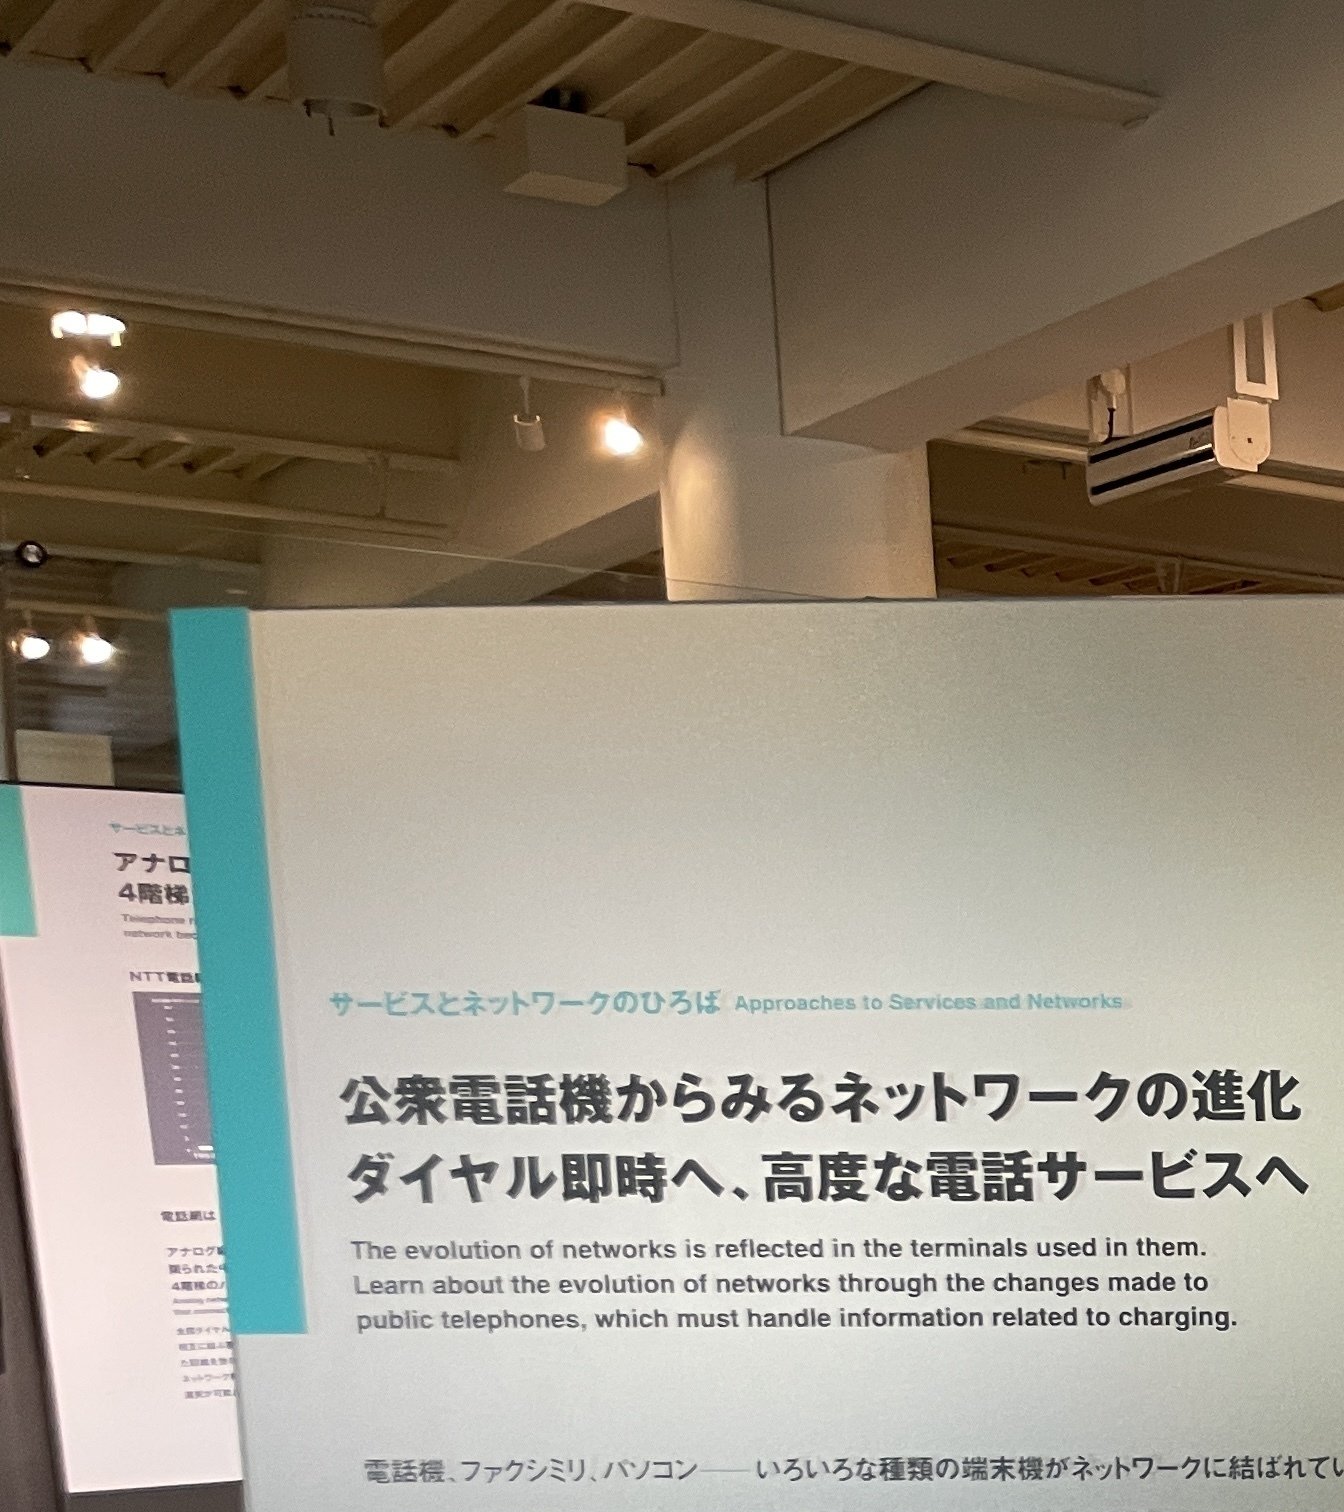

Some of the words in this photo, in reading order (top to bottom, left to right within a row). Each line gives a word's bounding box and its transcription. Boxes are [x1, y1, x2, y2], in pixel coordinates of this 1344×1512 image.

[112, 852, 190, 873] アナロ
[329, 990, 720, 1016] サービスとネットワークのひろば
[734, 995, 857, 1014] Approaches
[862, 995, 883, 1010] to
[888, 993, 977, 1011] Services
[984, 993, 1022, 1011] and
[1027, 992, 1123, 1010] Networks
[340, 1069, 1302, 1126] 公衆電話機からみるネットワークの進化
[347, 1149, 1310, 1203] ダイヤル即時へ、高度な電話サービスへ
[350, 1241, 397, 1260] The
[405, 1240, 521, 1259] evolution
[530, 1240, 553, 1259] of
[563, 1240, 677, 1259] networks
[685, 1239, 706, 1258] is
[715, 1239, 824, 1258] reflected
[832, 1238, 855, 1257] in
[863, 1238, 902, 1257] the
[910, 1238, 1028, 1257] terminals
[1037, 1238, 1096, 1257] used
[1106, 1237, 1127, 1256] in
[1136, 1237, 1206, 1256] them.
[353, 1276, 424, 1294] Learn
[433, 1276, 504, 1294] about
[510, 1275, 550, 1293] the
[558, 1274, 675, 1293] evolution
[684, 1274, 707, 1293] of
[716, 1274, 830, 1293] networks
[838, 1273, 937, 1297] through
[945, 1273, 985, 1292] the
[993, 1273, 1099, 1297] changes
[1108, 1272, 1176, 1291] made
[1184, 1273, 1208, 1291] to
[357, 1310, 434, 1334] public
[441, 1310, 587, 1333] telephones,
[595, 1309, 668, 1328] which
[677, 1310, 739, 1327] must
[747, 1308, 831, 1327] handle
[840, 1307, 983, 1327] information
[993, 1307, 1077, 1326] related
[1086, 1308, 1110, 1326] to
[1119, 1306, 1236, 1331] charging.
